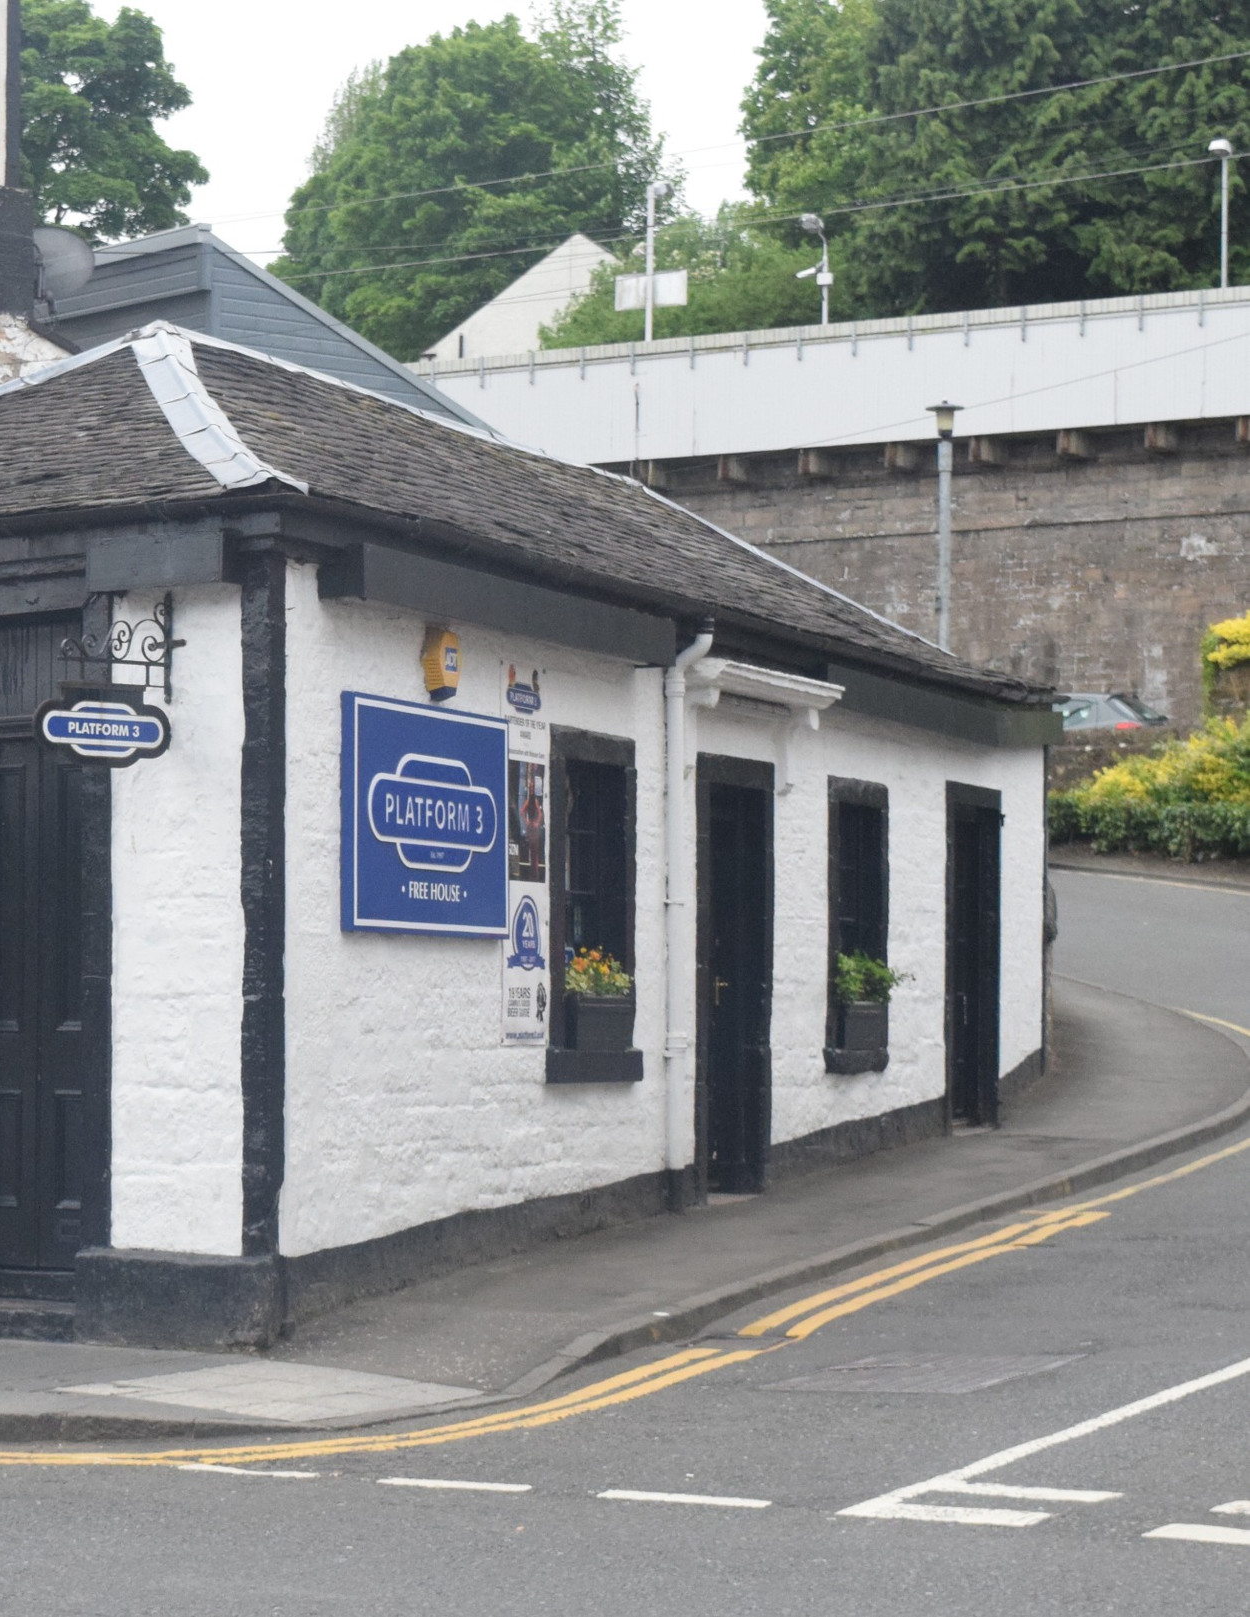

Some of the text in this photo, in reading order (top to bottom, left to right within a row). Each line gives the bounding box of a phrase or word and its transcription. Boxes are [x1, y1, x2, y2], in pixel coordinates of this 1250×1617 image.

[68, 722, 140, 738] PLATFORM 3
[385, 793, 483, 834] PLATFORM 3
[409, 881, 460, 902] FREE HOUSE
[522, 911, 534, 937] 20
